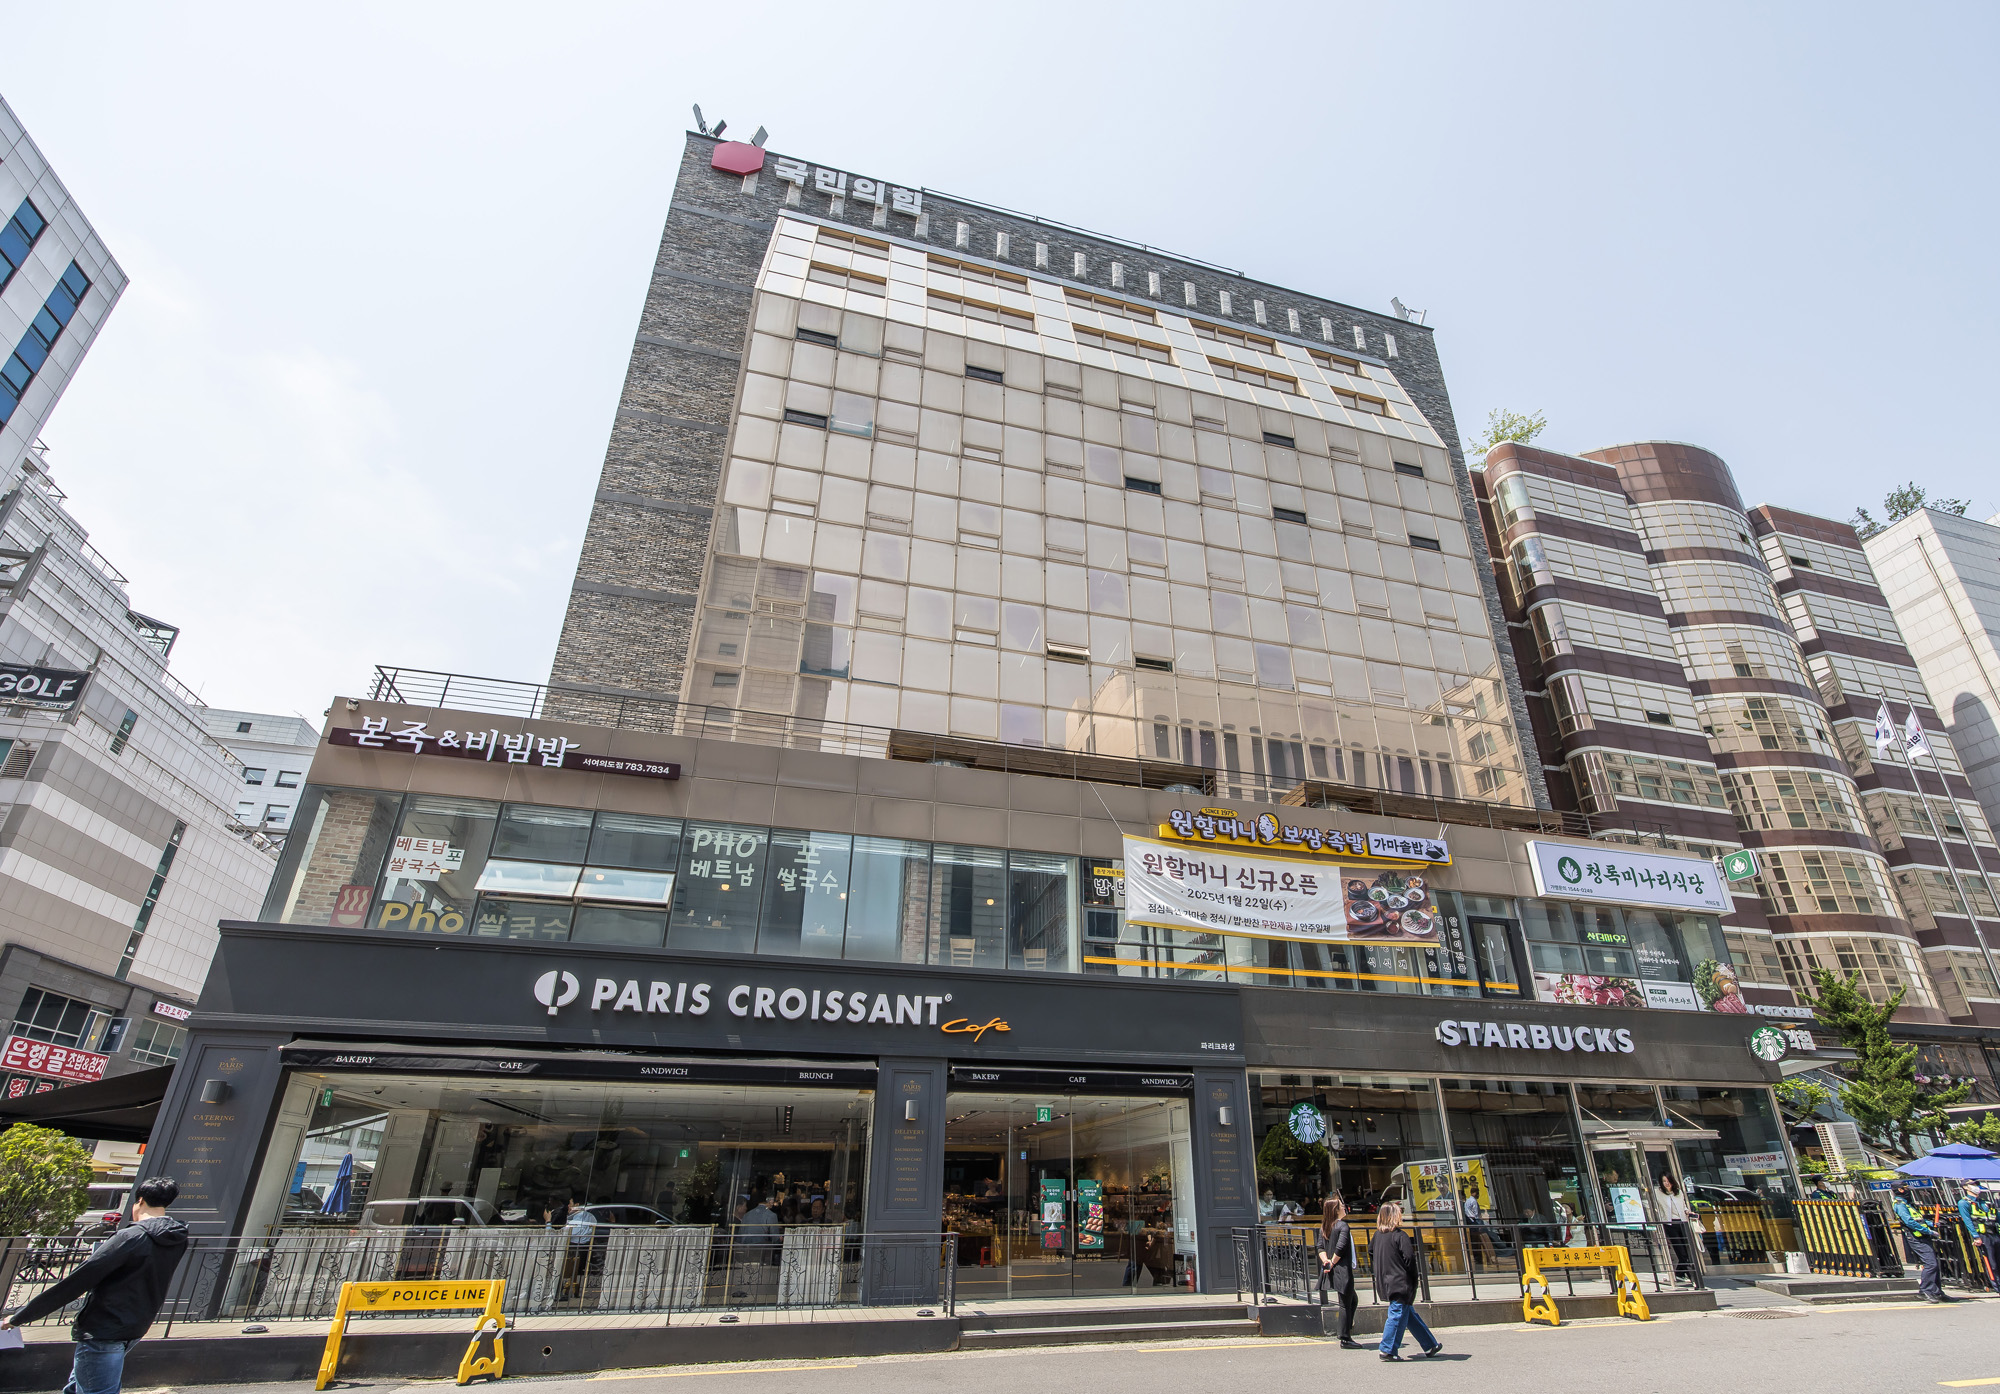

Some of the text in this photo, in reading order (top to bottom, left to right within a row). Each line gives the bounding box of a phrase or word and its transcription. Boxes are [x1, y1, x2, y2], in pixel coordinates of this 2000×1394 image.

[774, 156, 923, 217] 국민의힘
[0, 673, 77, 698] GOLF
[583, 758, 670, 774] 서여의도점 783.7834
[1220, 809, 1235, 817] 1975
[1168, 809, 1258, 842] 원할머니
[396, 838, 447, 854] 베트남
[794, 840, 821, 864] 포
[445, 850, 462, 862] 포
[391, 857, 441, 875] 쌀국수
[690, 859, 755, 886] 베트남
[1143, 853, 1318, 896] 원할머니 신규오픈
[777, 867, 839, 894] 쌀국수
[1586, 862, 1705, 895] 청록미나리식당
[1187, 888, 1287, 912] 2025년 1월 22일(수)
[478, 913, 568, 940] 쌀국수
[1209, 913, 1226, 925] 정식
[1261, 919, 1293, 931] 무한제공
[1299, 923, 1331, 933] 안주일체
[591, 977, 943, 1025] PARIS CROISSANT
[1438, 1019, 1635, 1053] STARBUCKS
[1200, 1042, 1236, 1051] 파리크라상
[6, 1040, 69, 1073] 은행골
[219, 1061, 244, 1069] PARIS
[336, 1055, 375, 1064] BAKERY
[499, 1062, 523, 1070] CAFE
[640, 1067, 688, 1076] SANDWICH
[799, 1072, 834, 1080] BRUNCH
[972, 1073, 1000, 1081] BAKERY
[1141, 1078, 1178, 1086] SANDWICH
[1553, 1252, 1601, 1262] 질서유지선
[393, 1288, 486, 1301] POLICE LINE
